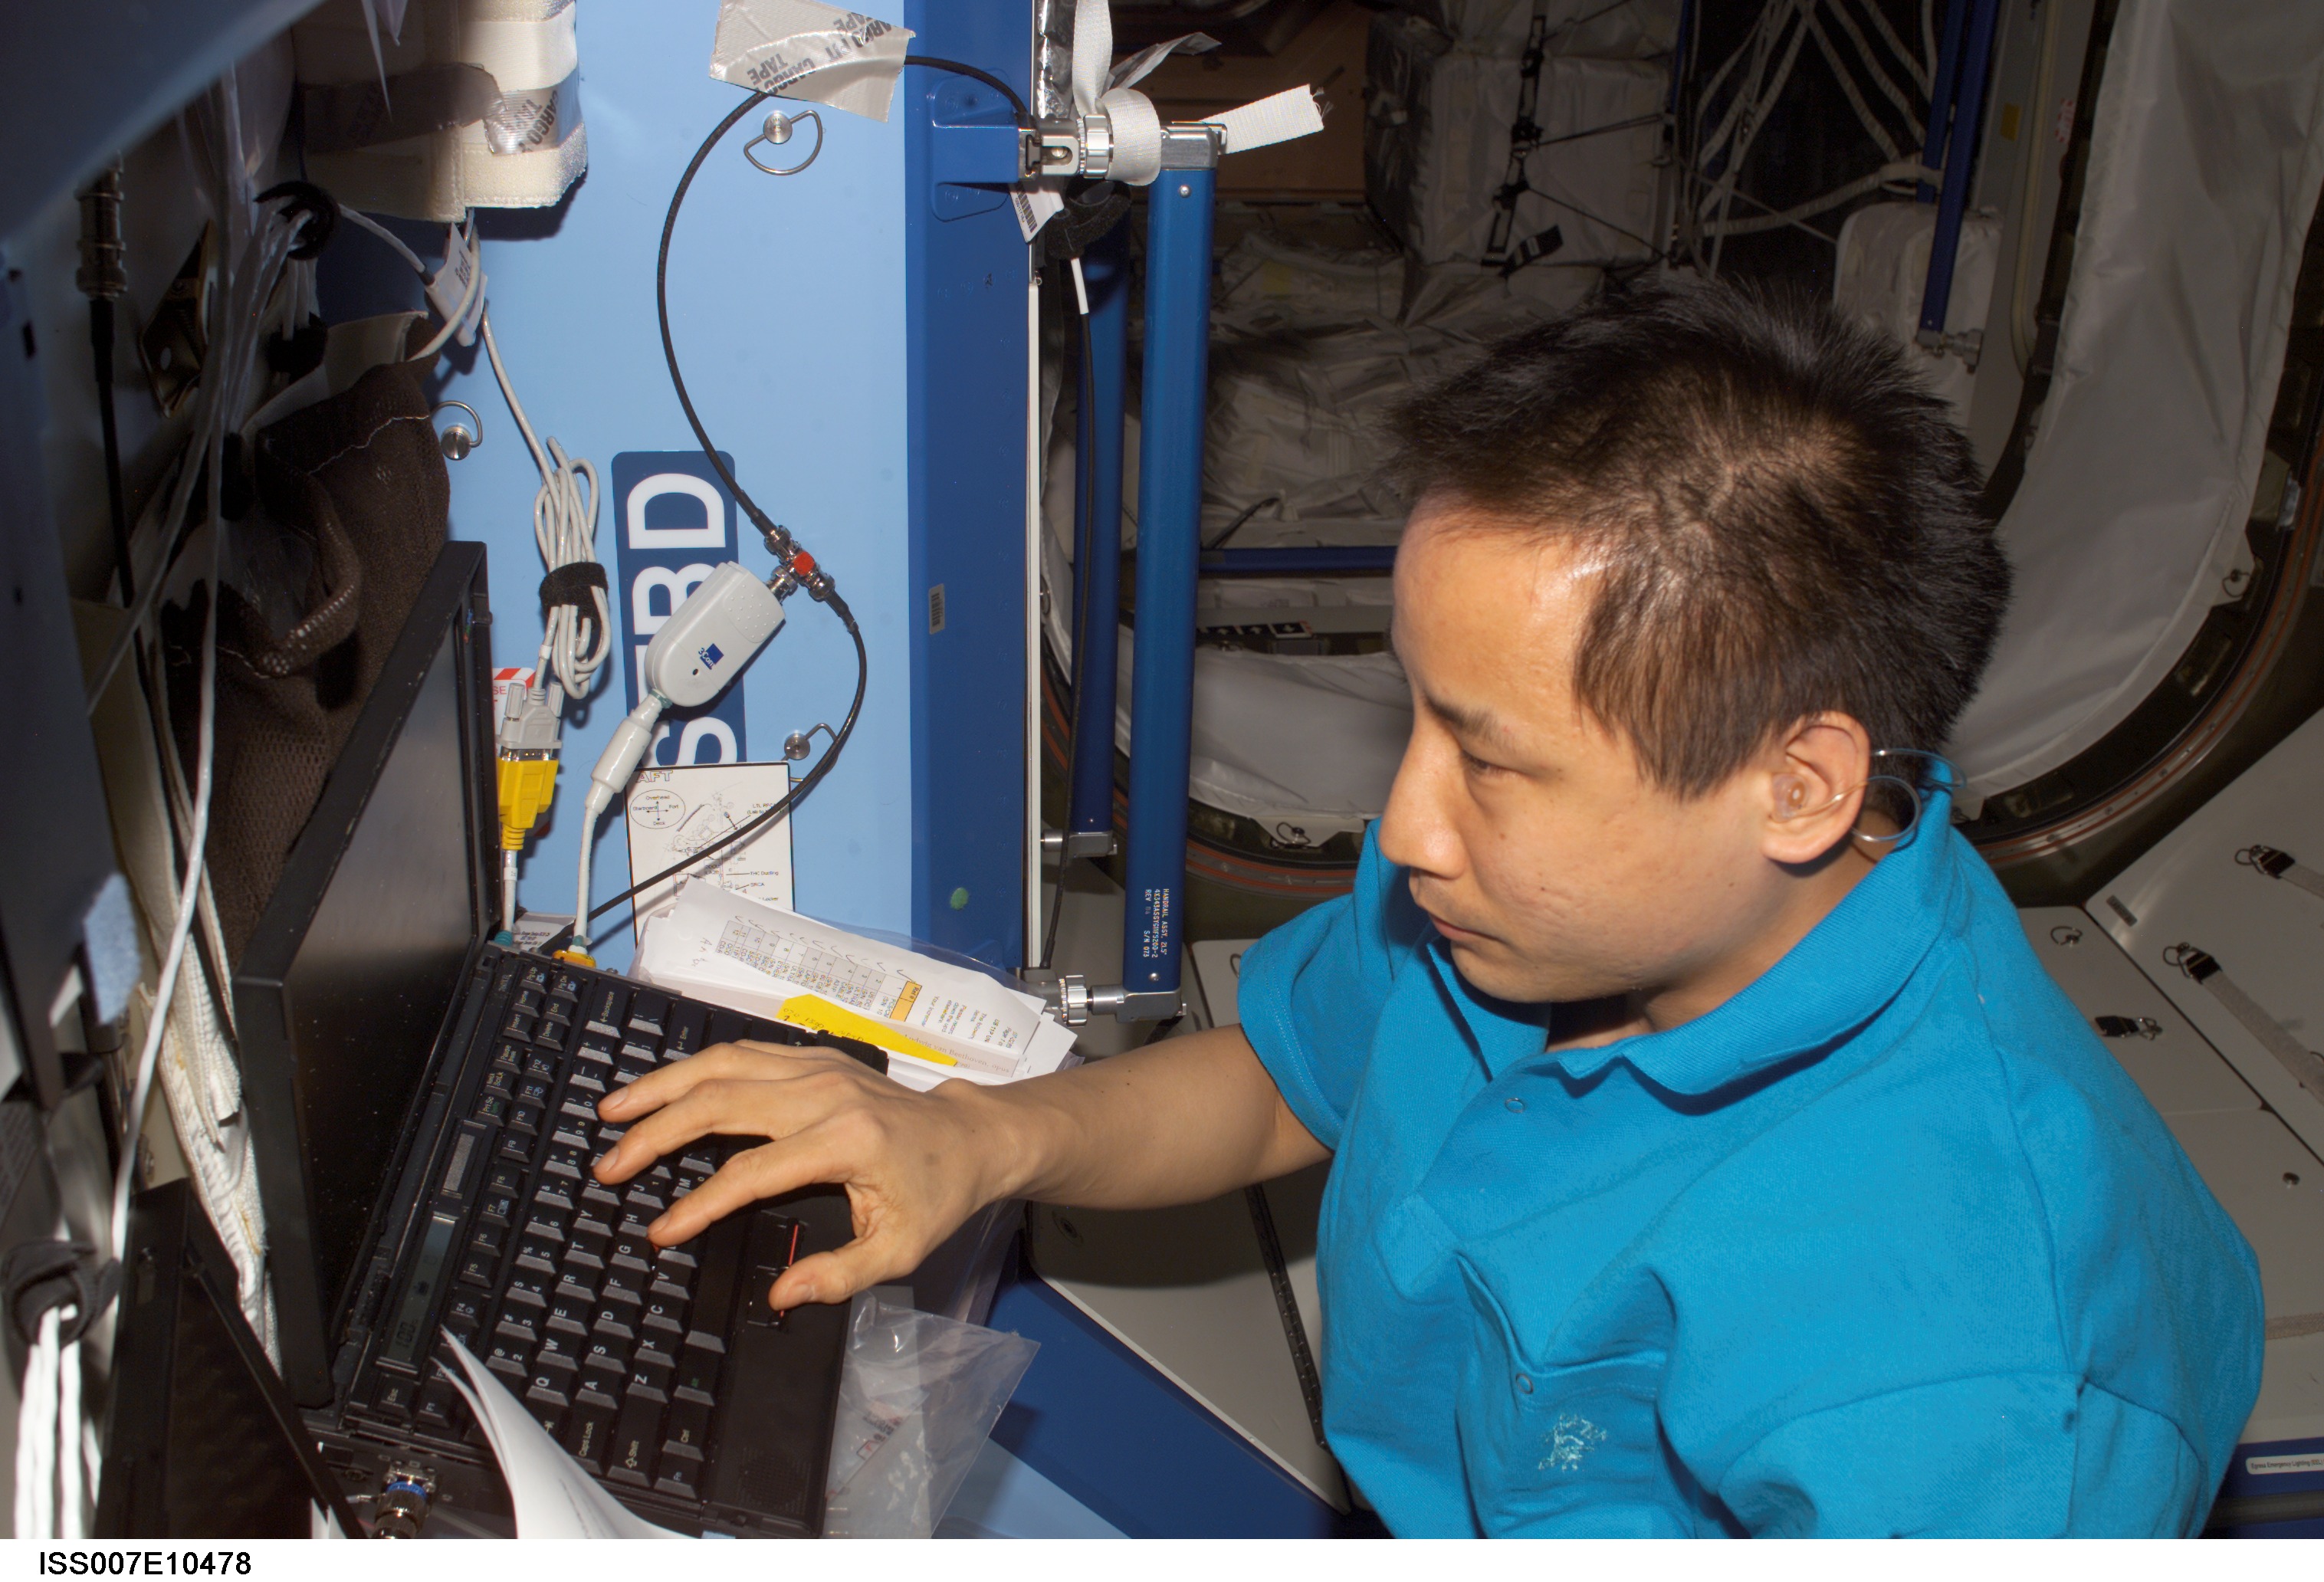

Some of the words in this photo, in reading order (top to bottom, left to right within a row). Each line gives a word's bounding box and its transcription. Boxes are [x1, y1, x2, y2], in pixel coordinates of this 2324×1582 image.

[747, 53, 789, 86] TAPE
[527, 90, 558, 145] CARGO
[698, 647, 714, 668] 3Com
[636, 770, 673, 783] AFT
[1161, 888, 1170, 917] HANDRAIL
[550, 1003, 560, 1013] End
[511, 1013, 521, 1029] Insert
[543, 1022, 553, 1037] Delete
[680, 1026, 689, 1040] Enter
[532, 1058, 541, 1069] F12
[934, 1045, 947, 1055] van
[949, 1049, 991, 1068] Beethoven,
[991, 1064, 1009, 1074] opus
[525, 1085, 534, 1095] F11
[517, 1111, 526, 1121] F10
[507, 1140, 517, 1148] F9
[497, 1175, 506, 1184] F8
[678, 1178, 691, 1188] M
[633, 1183, 645, 1192] J
[487, 1204, 496, 1213] F7
[579, 1209, 593, 1219] Y
[625, 1213, 638, 1223] H
[478, 1233, 487, 1242] F6
[571, 1241, 584, 1249] T
[618, 1245, 632, 1254] G
[469, 1263, 478, 1272] F5
[563, 1274, 576, 1284] R
[657, 1272, 670, 1281] V
[609, 1278, 622, 1287] F
[456, 1302, 466, 1311] F4
[650, 1305, 663, 1315] C
[553, 1308, 567, 1318] E
[601, 1311, 614, 1321] D
[544, 1338, 559, 1351] W
[642, 1339, 655, 1349] X
[592, 1345, 606, 1355] S
[536, 1377, 550, 1387] Q
[635, 1374, 648, 1385] Z
[584, 1380, 598, 1390] A
[583, 1421, 594, 1439] Lock
[681, 1429, 691, 1443] Ctrl
[578, 1439, 590, 1457] Caps
[629, 1439, 639, 1457] Shift
[2267, 1461, 2291, 1469] Emergency
[673, 1471, 682, 1481] Fn
